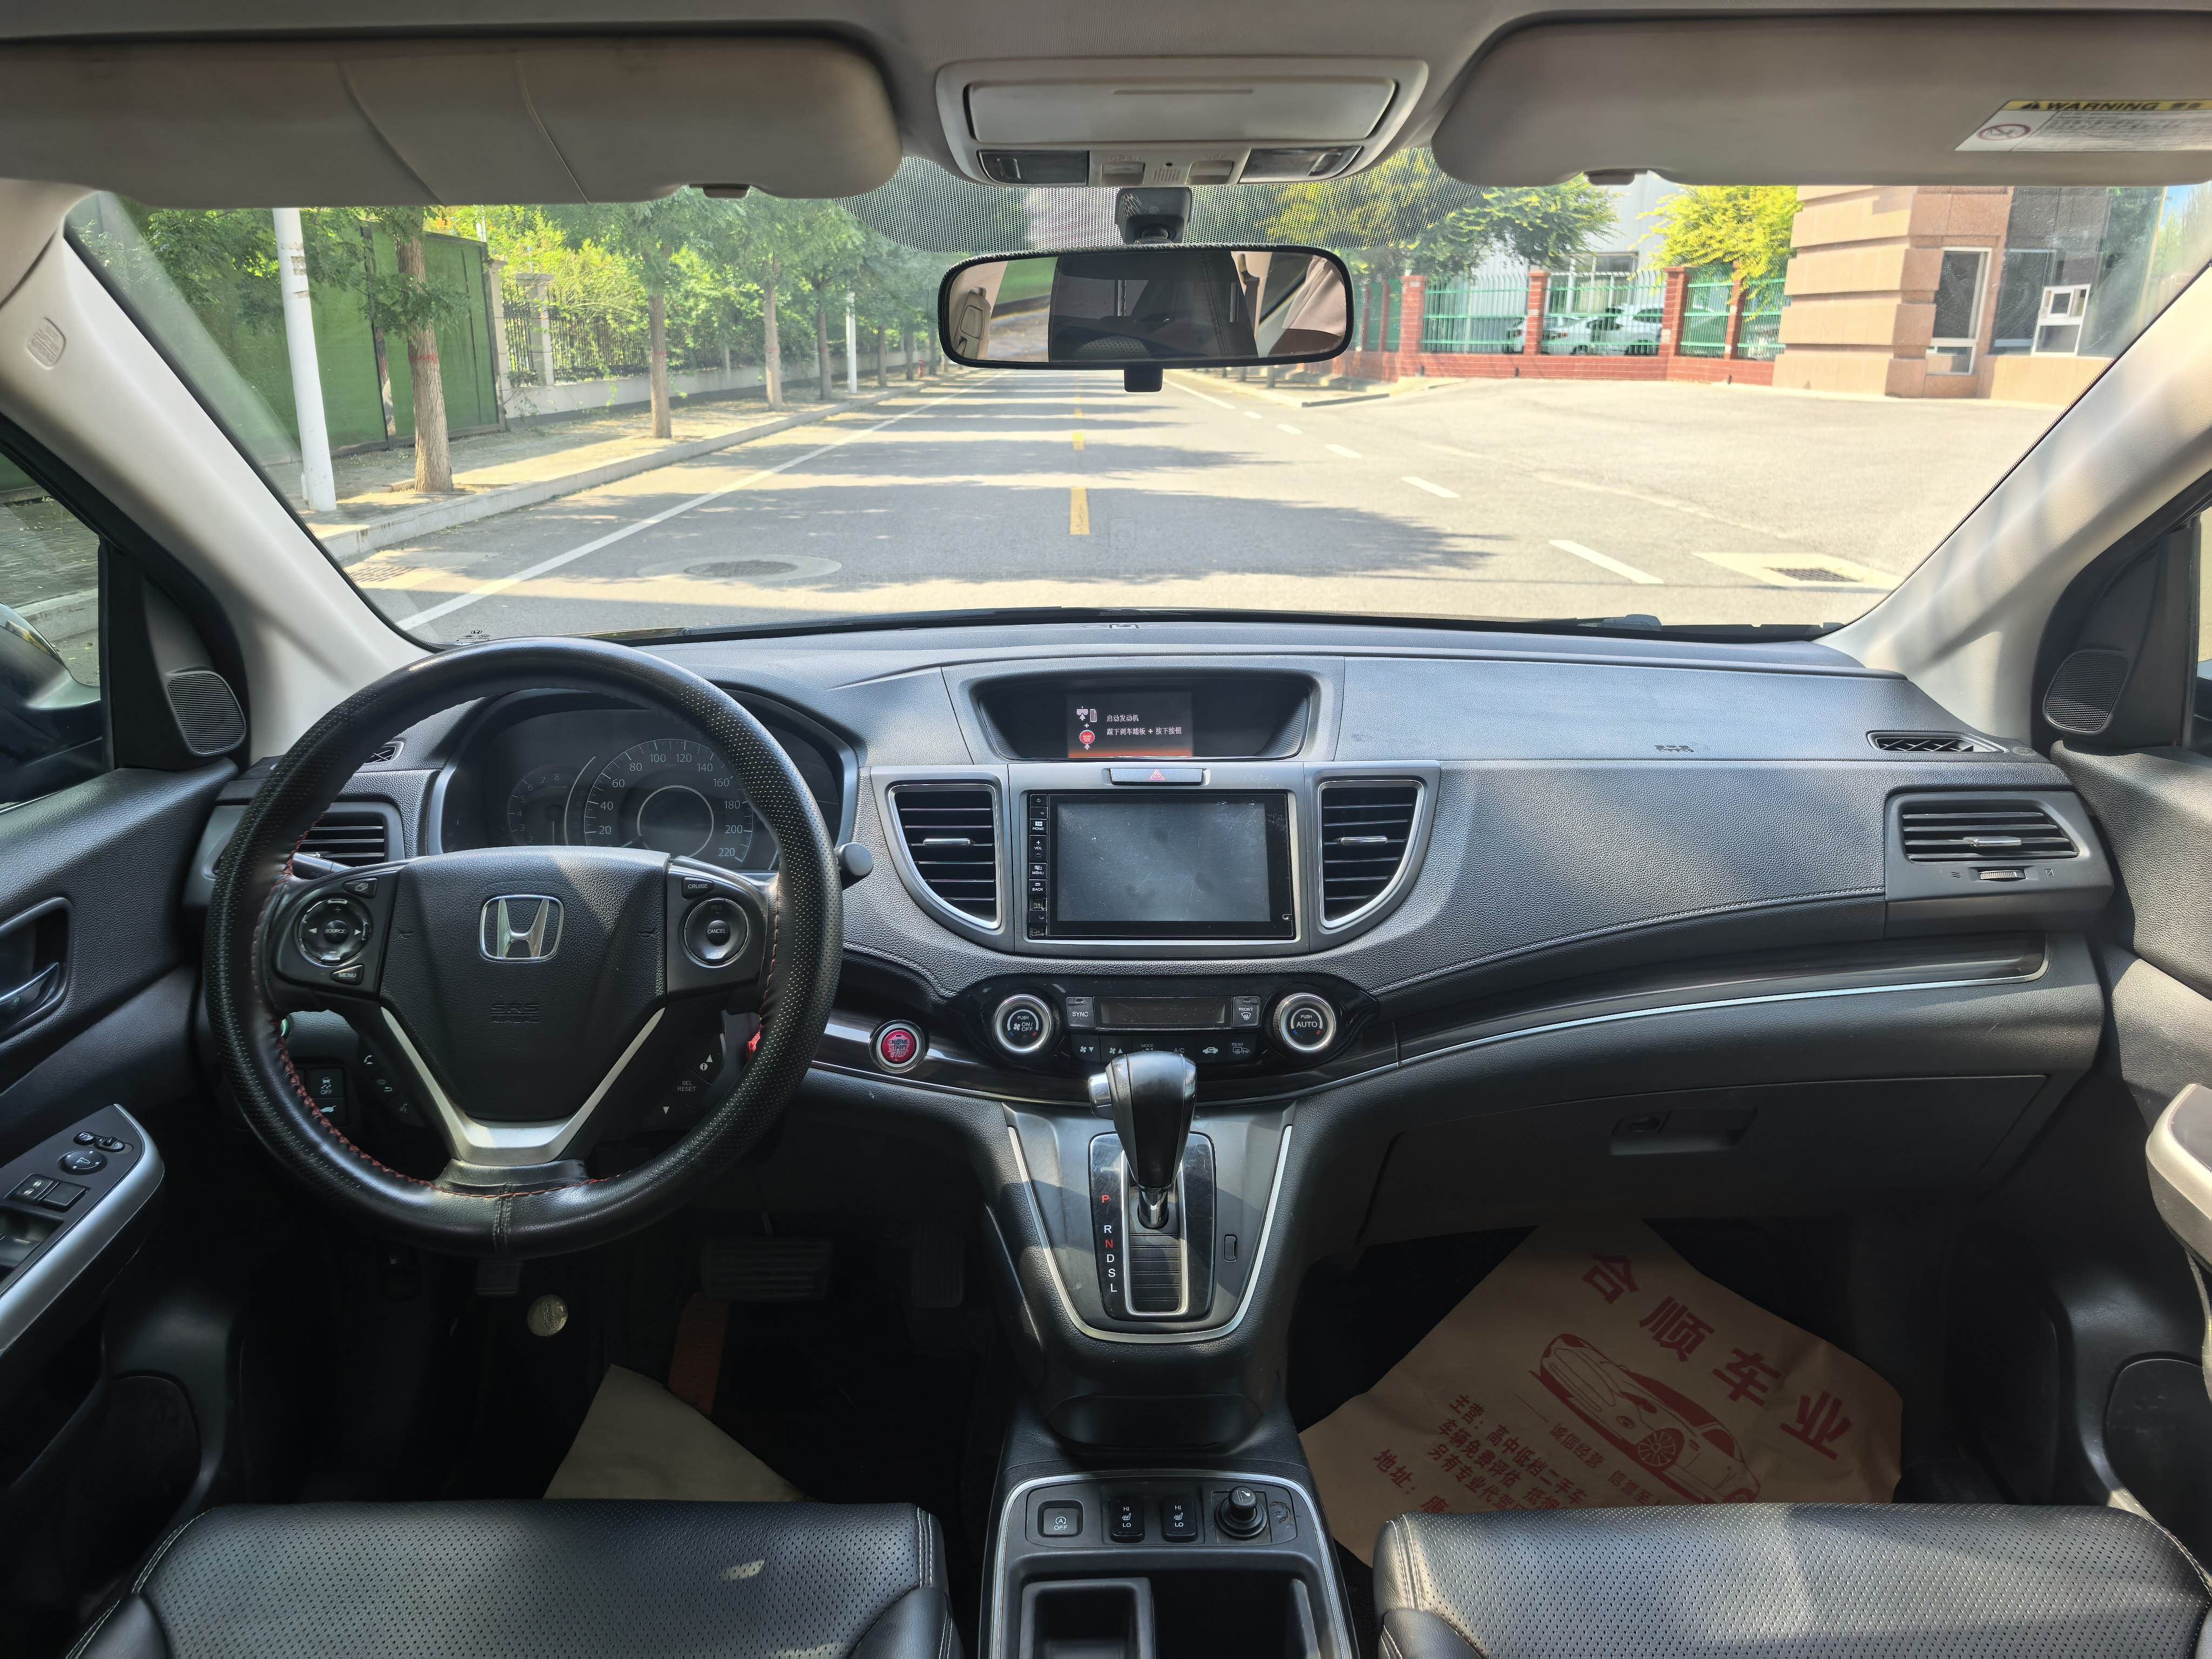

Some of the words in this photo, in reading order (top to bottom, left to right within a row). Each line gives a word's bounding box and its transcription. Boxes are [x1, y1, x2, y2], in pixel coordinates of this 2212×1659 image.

[2047, 102, 2161, 111] WARNING
[1107, 714, 1139, 723] 启动发动机
[1107, 727, 1145, 736] 踩下刹车踏板
[650, 753, 666, 763] 100
[676, 753, 692, 763] 120
[630, 763, 642, 771] 80
[697, 763, 713, 772] 140
[612, 779, 625, 787] 60
[713, 778, 729, 787] 160
[601, 801, 613, 810] 40
[725, 800, 740, 809] 180
[599, 825, 611, 834] 20
[725, 825, 743, 834] 200
[718, 847, 735, 857] 220
[1101, 1195, 1110, 1203] P
[1104, 1225, 1112, 1233] R
[1105, 1239, 1113, 1249] N
[1107, 1254, 1115, 1263] D
[1108, 1268, 1116, 1278] S
[1110, 1283, 1117, 1292] L
[1582, 1253, 1852, 1460] 合顺车业
[1550, 1422, 1604, 1469] 诚信经营
[1439, 1418, 1521, 1488] 车辆免费评估
[1427, 1443, 1527, 1511] 另有专业代驾
